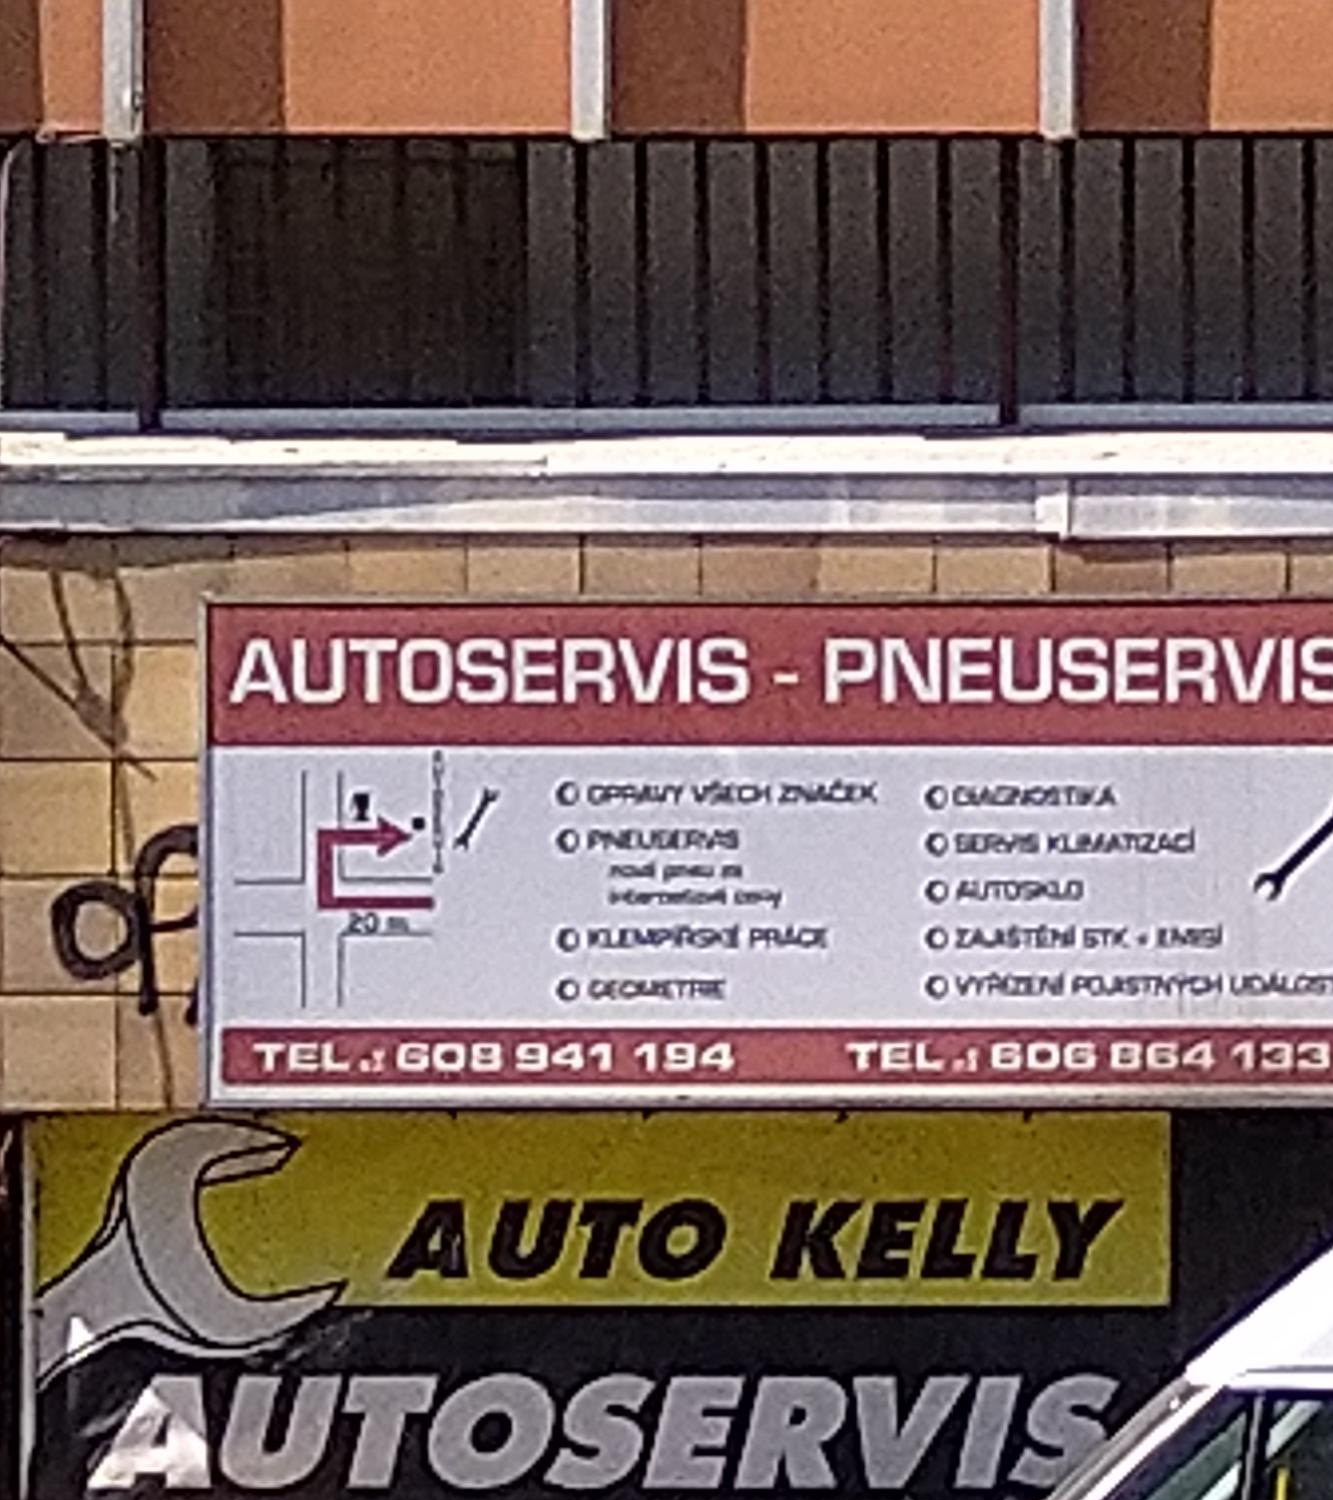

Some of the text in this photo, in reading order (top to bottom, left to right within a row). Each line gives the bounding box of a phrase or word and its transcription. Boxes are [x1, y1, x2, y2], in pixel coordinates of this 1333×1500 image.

[230, 637, 750, 704] AUTOSERVIS
[772, 672, 799, 684] -
[586, 779, 878, 805] OPRAVY VŠECH ZNAČEK
[952, 785, 1117, 808] DIAGNOSTIKA
[586, 829, 740, 850] PNEUSERVIS
[955, 827, 1196, 854] SERVIS KLIMATIZACÍ
[955, 879, 1085, 901] AUTOSKLO
[348, 911, 379, 934] 20
[587, 923, 828, 949] KLEMPÍŘSKÉ PRÁCE
[1082, 927, 1130, 949] STK
[587, 978, 727, 1001] GEOMETRIE
[1071, 973, 1223, 997] POJISTNÝCH
[253, 1042, 735, 1073] TEL.: 608 941 194
[845, 1041, 1331, 1072] TEL.: 606 864 133
[386, 1197, 1125, 1280] AUTO KELLY
[86, 1373, 1121, 1491] AUTOSERVIS
